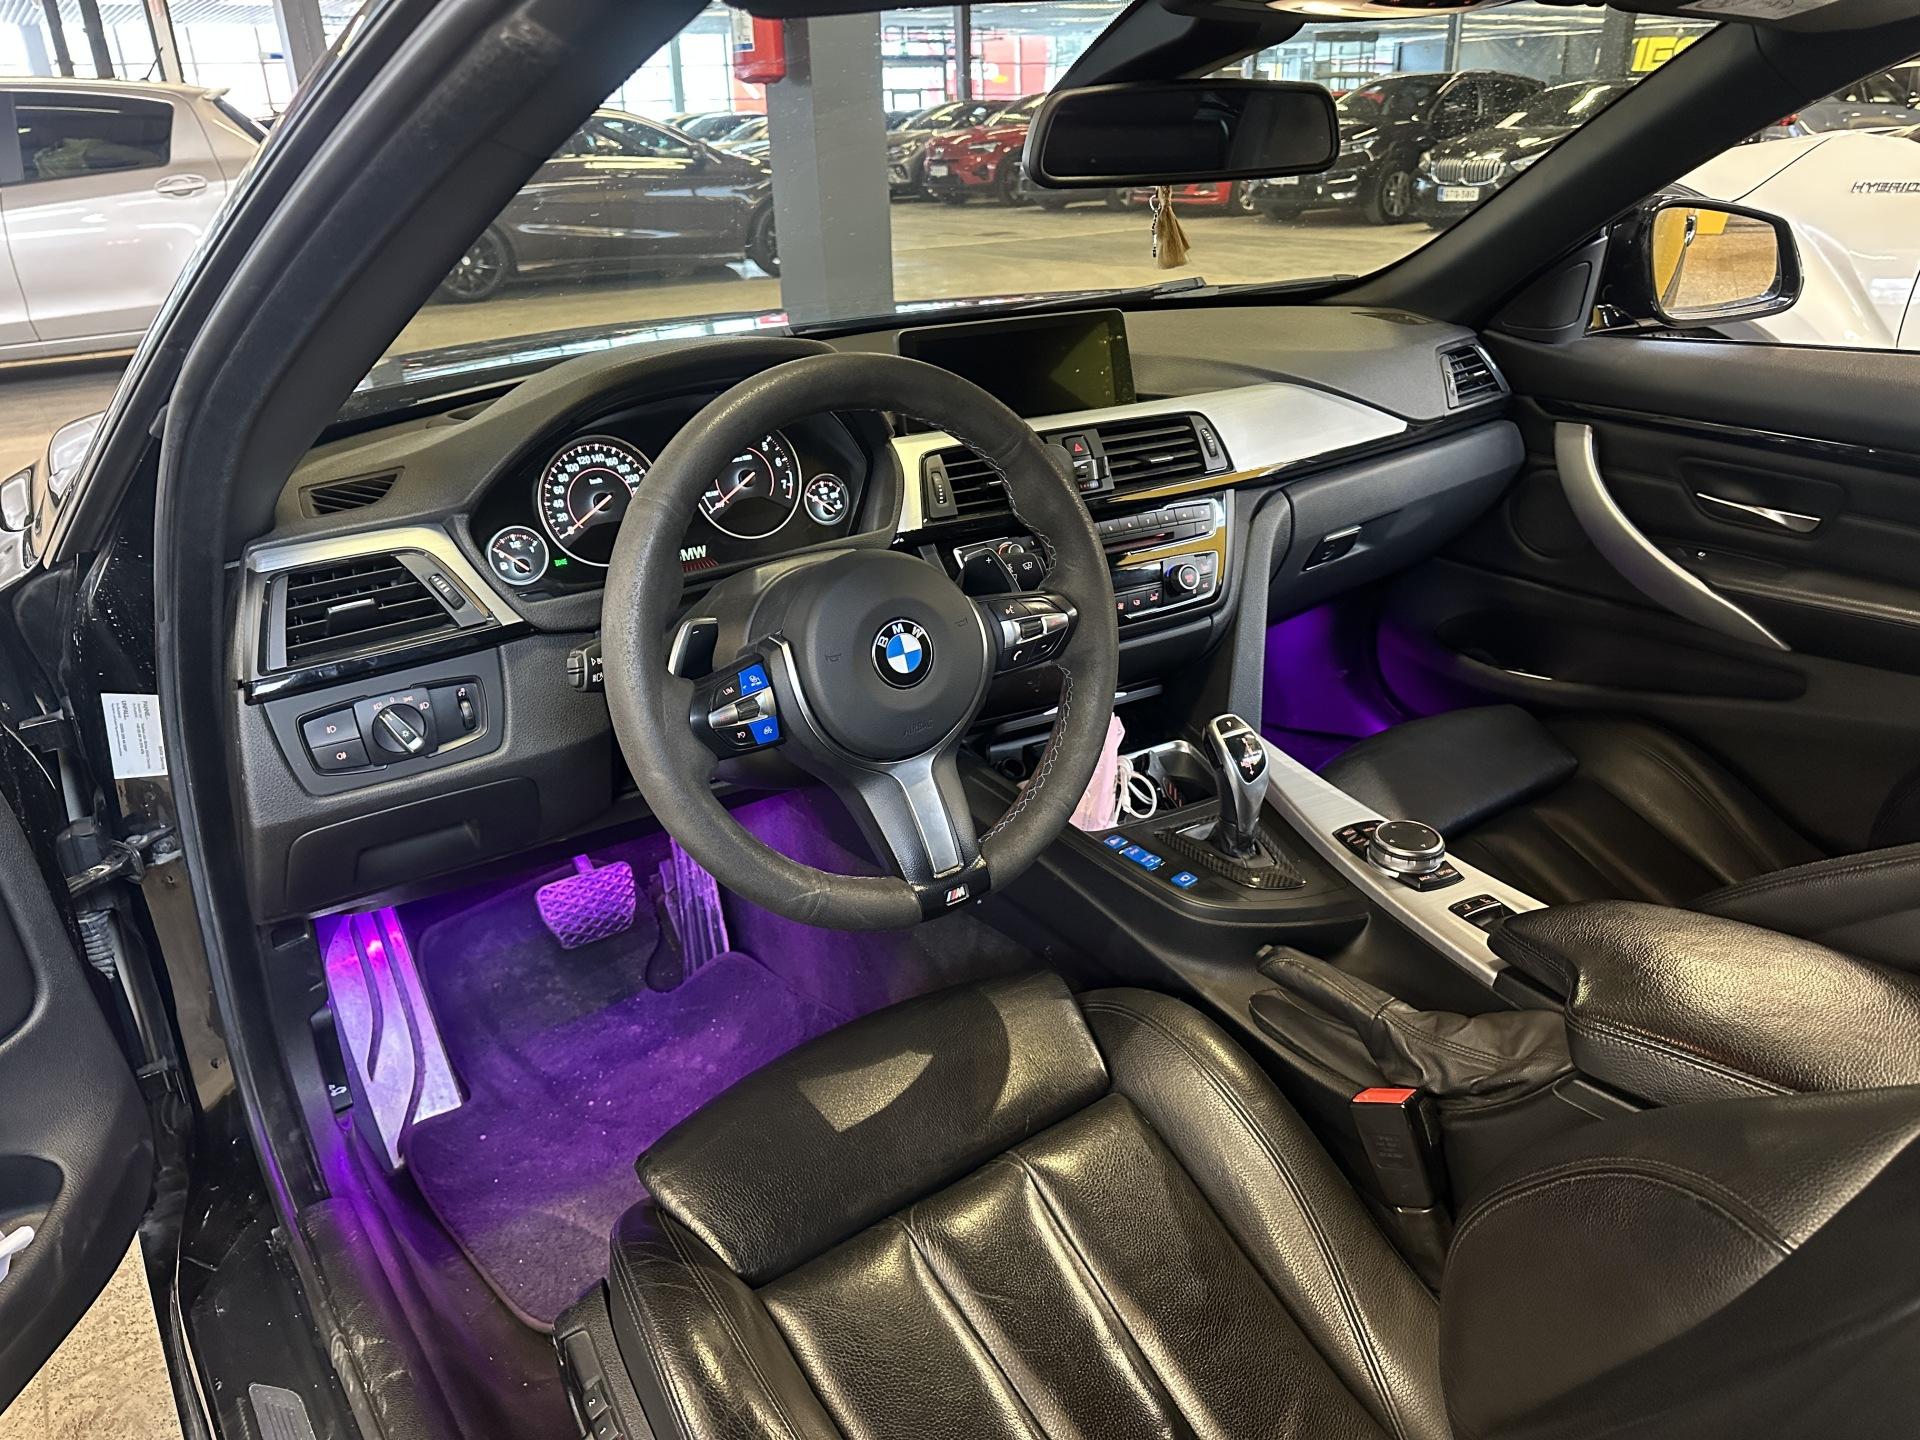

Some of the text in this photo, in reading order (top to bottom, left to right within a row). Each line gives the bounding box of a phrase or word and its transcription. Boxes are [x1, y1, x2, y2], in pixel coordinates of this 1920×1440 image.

[761, 441, 769, 451] 5
[577, 455, 591, 465] 120
[591, 453, 605, 462] 140
[605, 457, 618, 466] 160
[775, 457, 782, 467] 6
[565, 463, 579, 473] 100
[617, 464, 630, 473] 180
[558, 473, 569, 483] 80
[625, 474, 640, 483] 200
[553, 485, 564, 494] 60
[553, 499, 564, 508] 40
[556, 513, 568, 522] 20
[680, 545, 707, 562] MW
[878, 622, 924, 648] BMW
[588, 1398, 596, 1406] 2
